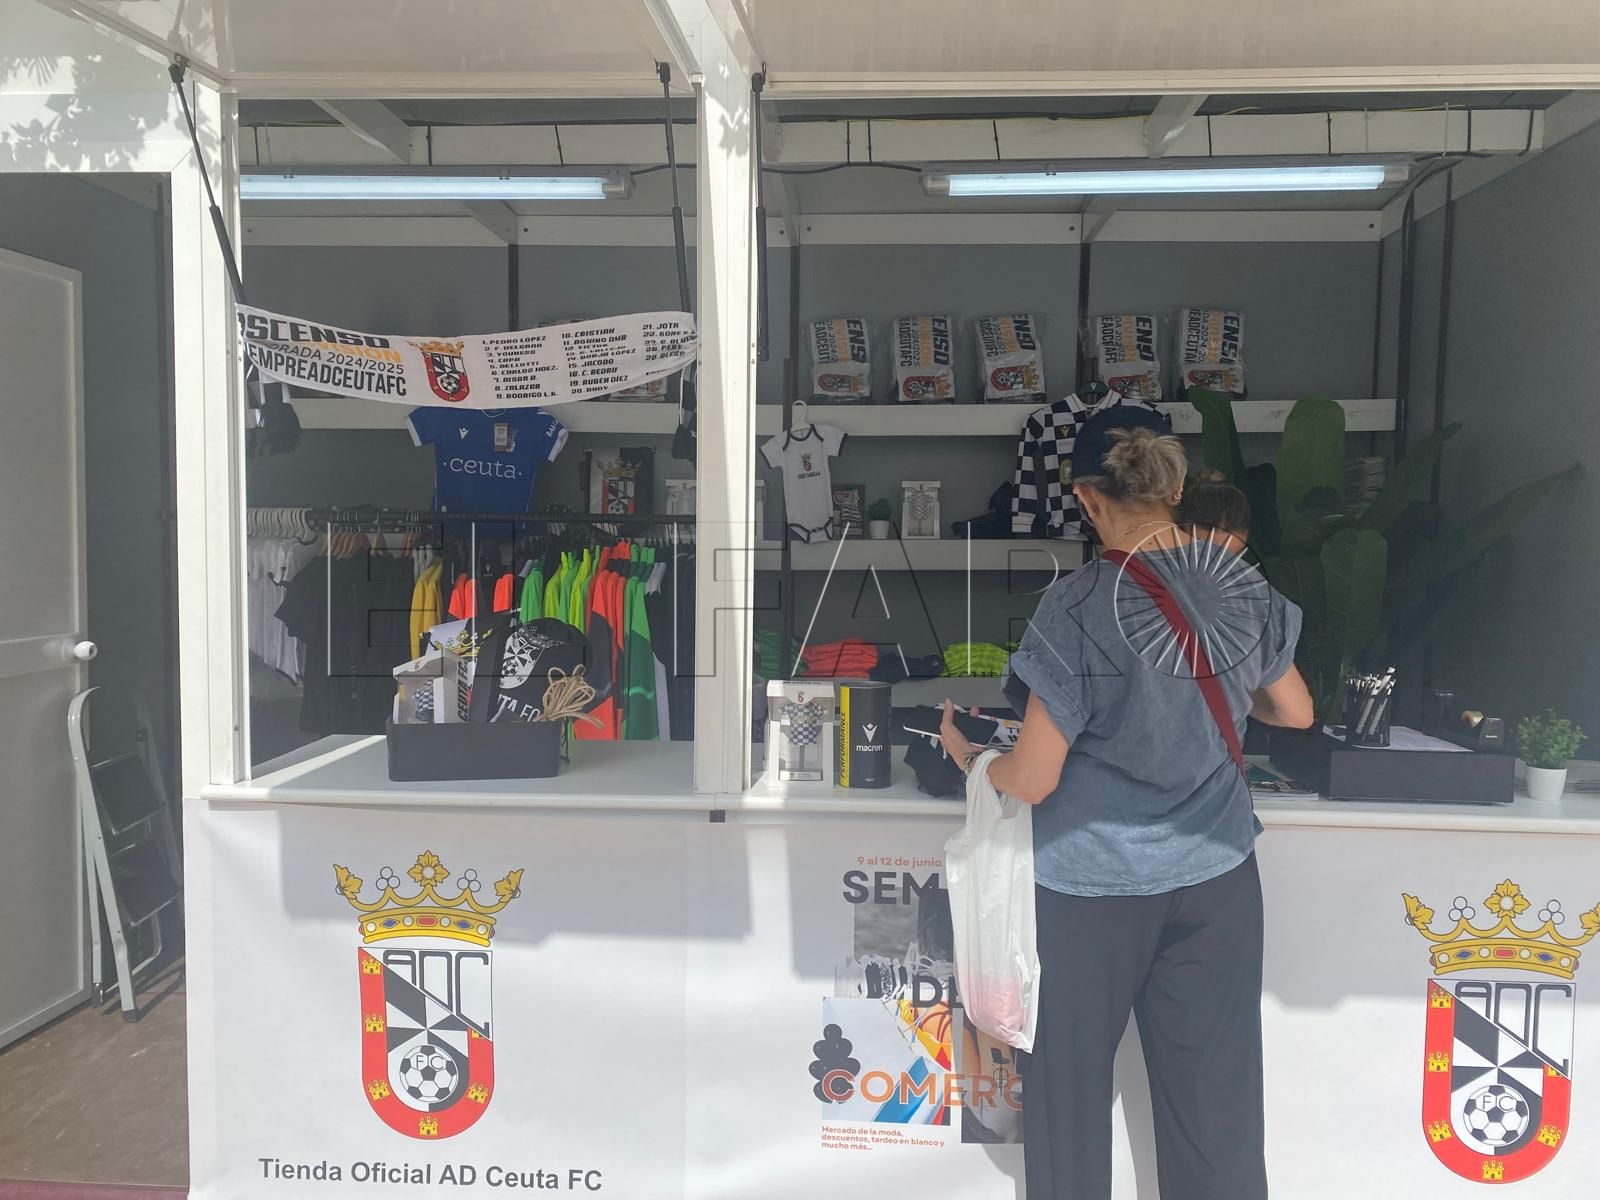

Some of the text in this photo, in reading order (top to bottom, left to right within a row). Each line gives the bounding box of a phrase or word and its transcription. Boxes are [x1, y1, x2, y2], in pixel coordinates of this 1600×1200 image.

[575, 328, 615, 338] CRISTIAN
[327, 351, 404, 375] 2024/2025
[501, 368, 534, 376] CARLOS
[583, 377, 609, 385] RUBEN
[450, 456, 516, 479] ceuta
[458, 679, 468, 722] CEUTA
[856, 744, 883, 752] macron
[858, 856, 942, 868] 9 al 12 de junio
[822, 1126, 904, 1138] Mercado de la moda,
[822, 1134, 870, 1144] descuentos,
[871, 1136, 898, 1144] tardeo
[911, 1138, 938, 1146] blanco
[822, 1141, 849, 1149] mucho
[258, 1158, 602, 1191] Tienda Oficial AD Ceuta FC
